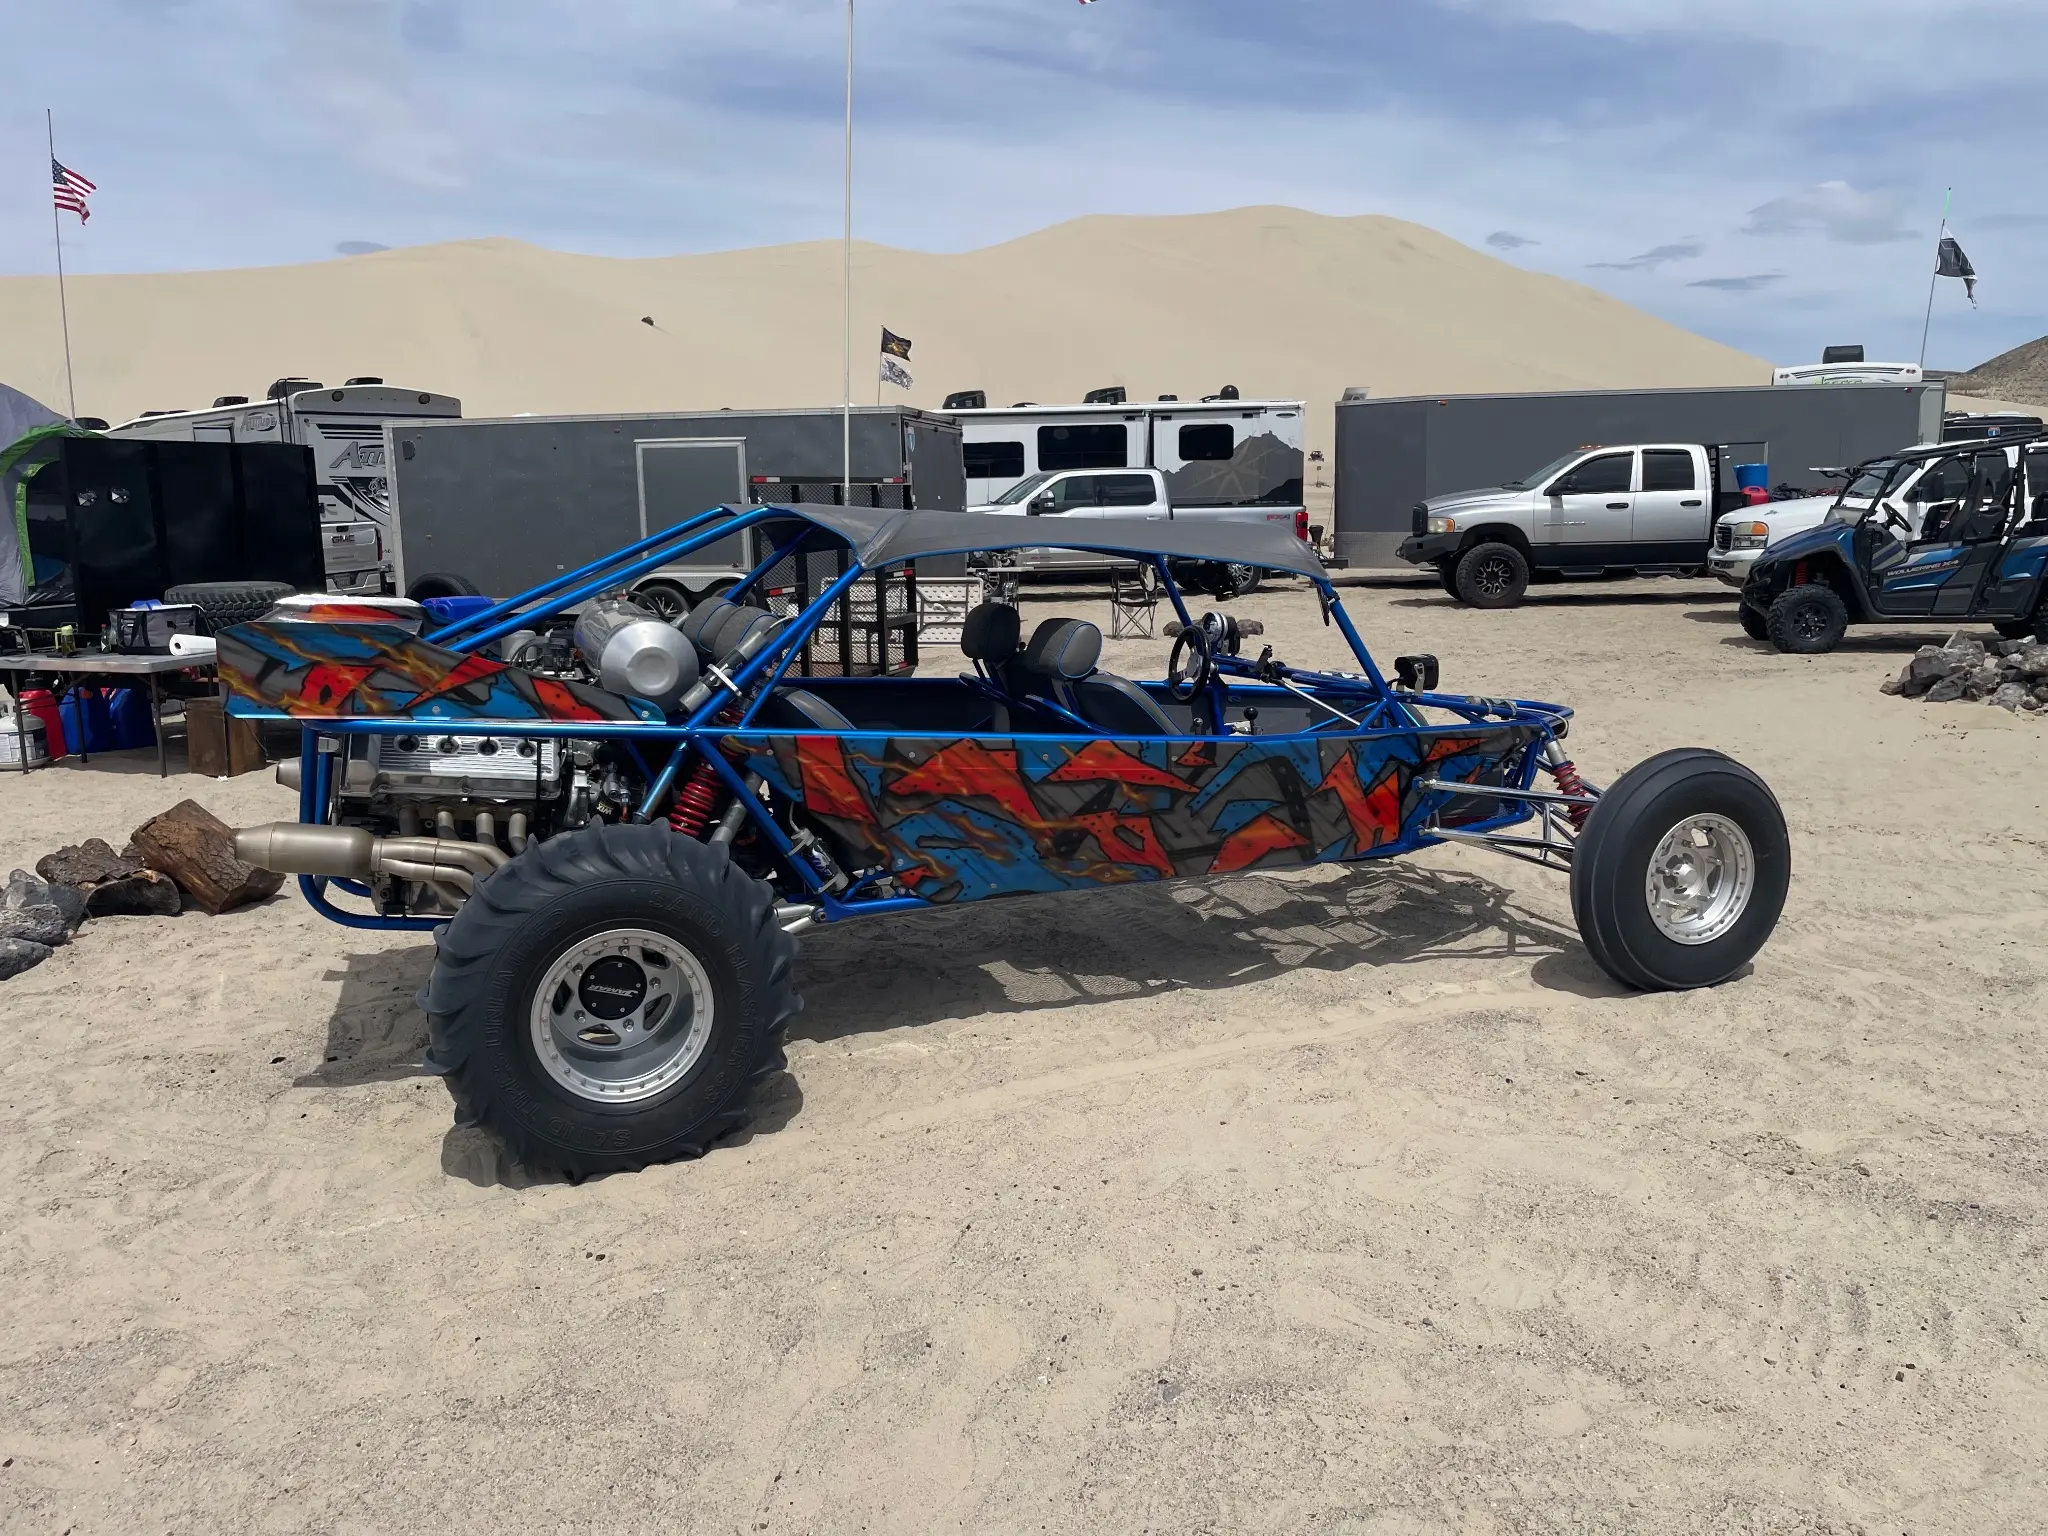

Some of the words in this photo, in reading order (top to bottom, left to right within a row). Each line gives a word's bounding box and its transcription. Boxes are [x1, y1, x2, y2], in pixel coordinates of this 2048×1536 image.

[331, 535, 355, 544] GMC
[484, 908, 566, 1048] UNLIMITED
[649, 889, 721, 937] SAND
[725, 944, 758, 1069] BLASTER
